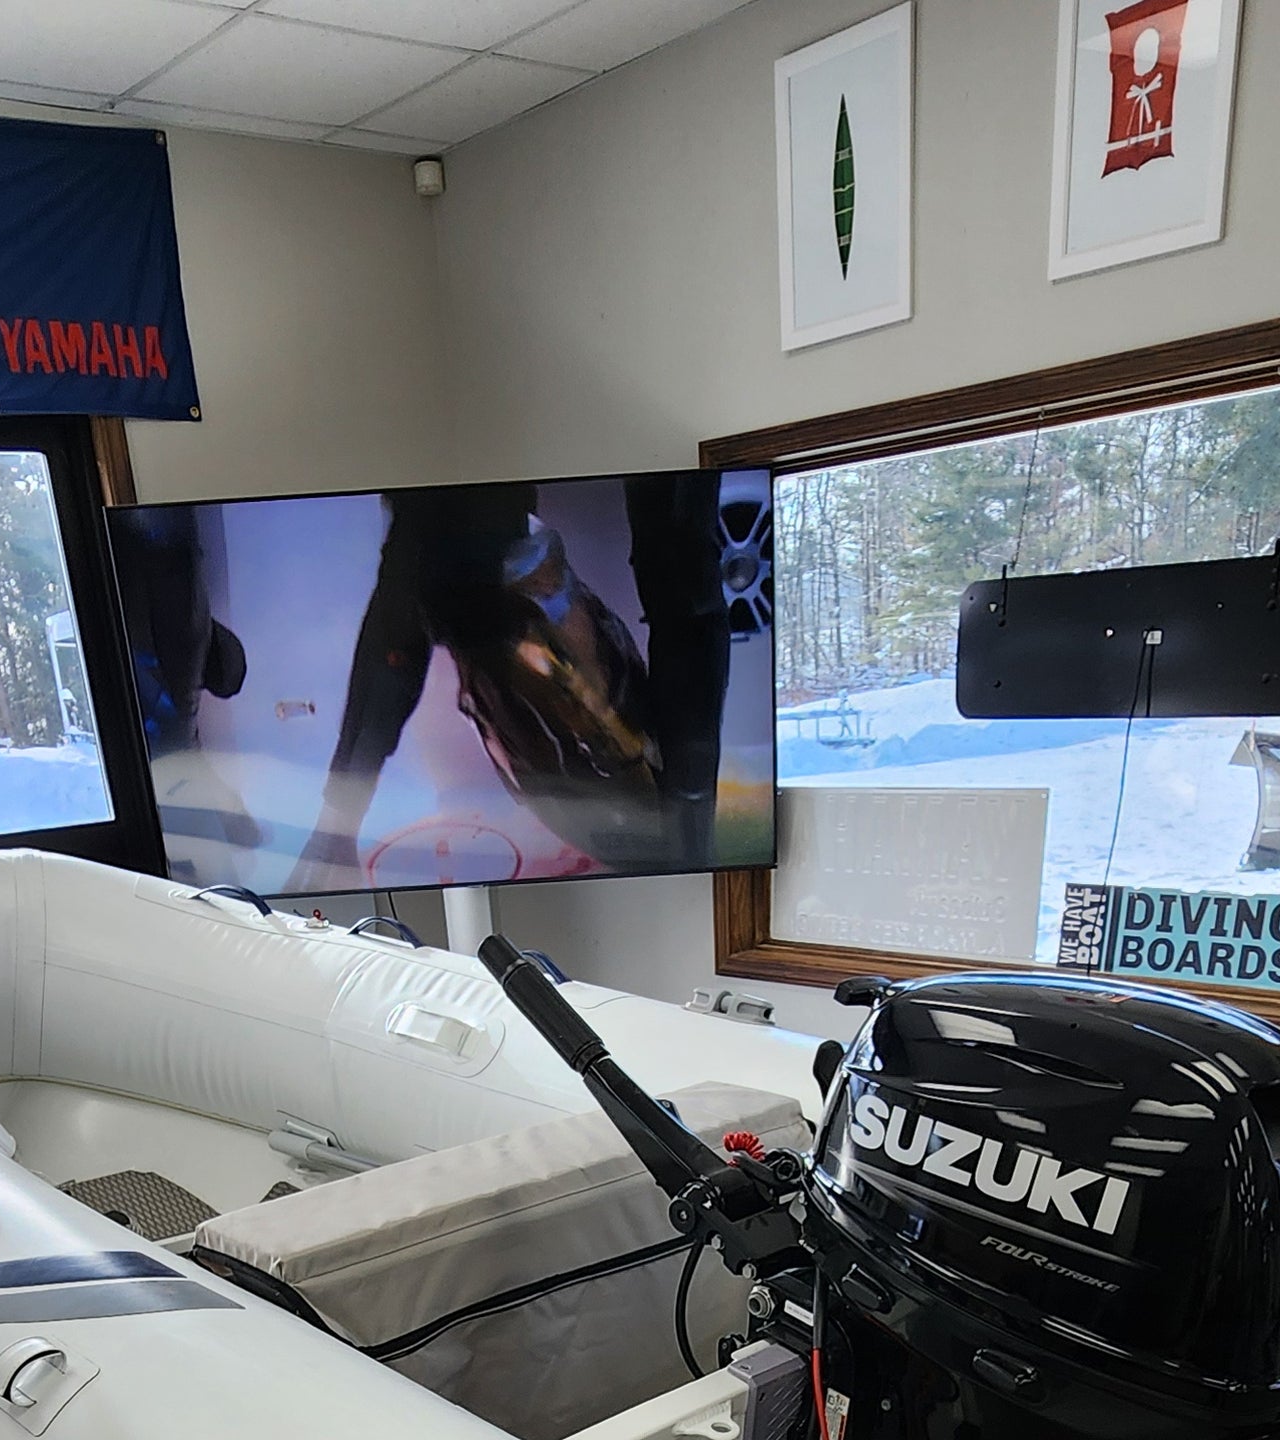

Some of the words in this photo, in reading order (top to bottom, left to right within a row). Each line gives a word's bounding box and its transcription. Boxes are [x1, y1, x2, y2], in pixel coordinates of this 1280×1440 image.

[1062, 887, 1085, 932] HAVE
[1075, 887, 1107, 965] BOAT
[1058, 937, 1080, 964] WE
[850, 1094, 1130, 1235] SUZUKI
